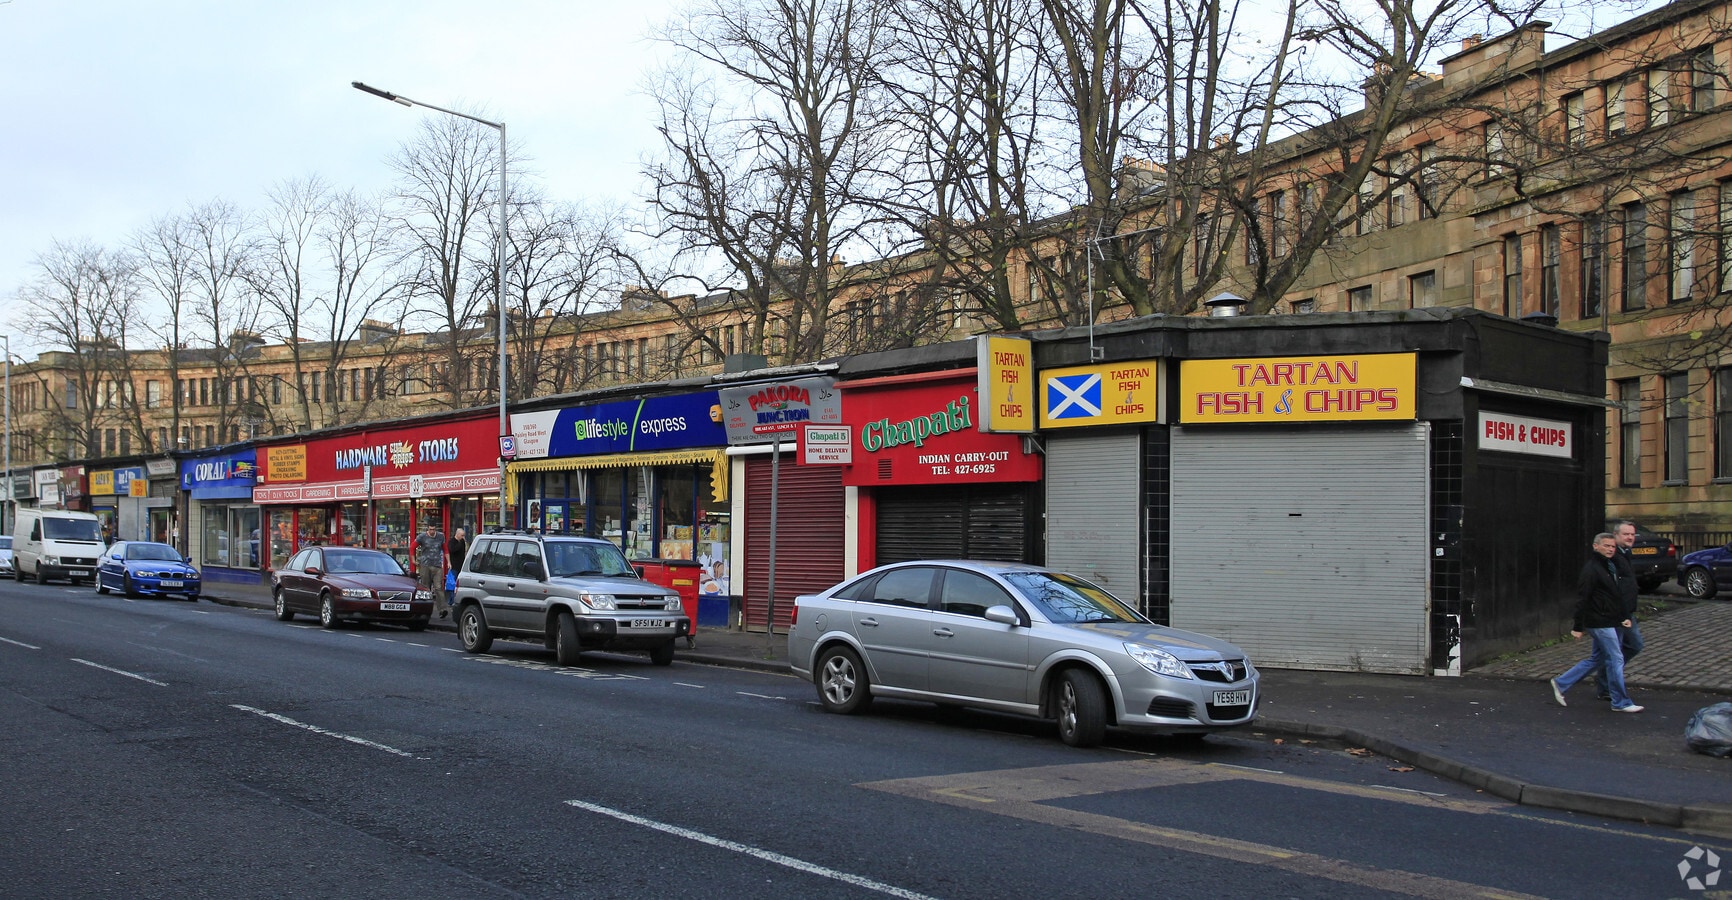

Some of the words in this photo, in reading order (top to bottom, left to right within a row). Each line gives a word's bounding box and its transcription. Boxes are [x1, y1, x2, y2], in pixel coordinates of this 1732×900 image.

[995, 352, 1025, 367] TARTAN
[1001, 370, 1019, 383] FISH
[1110, 368, 1150, 380] TARTAN
[1232, 360, 1359, 387] TARTAN
[1007, 384, 1014, 403] &
[1118, 381, 1141, 391] FISH
[748, 385, 811, 411] PAKORA
[1125, 391, 1133, 404] &
[1196, 391, 1264, 415] FISH
[1273, 388, 1294, 416] &
[1304, 388, 1399, 413] CHIPS
[756, 408, 810, 424] JUNCTION
[1000, 404, 1023, 418] CHIPS
[1115, 404, 1144, 415] CHIPS
[641, 416, 687, 437] express
[861, 395, 972, 452] Chapati
[1485, 420, 1515, 441] FISH
[1518, 424, 1527, 442] &
[1530, 426, 1566, 447] CHIPS
[335, 445, 387, 470] HARDWARE
[418, 437, 459, 462] STORES
[393, 452, 415, 464] PRICE
[918, 454, 950, 464] INDIAN
[954, 451, 1009, 462] CARRY-OUT
[195, 462, 226, 481] CORAL
[931, 466, 950, 475] TEL:
[954, 464, 995, 475] 427-6925
[283, 490, 297, 498] TOOLS
[380, 483, 409, 493] ELECTRICAL
[423, 479, 462, 490] ONMONGERY
[466, 476, 500, 487] SEASONAL
[1216, 692, 1234, 703] YE58
